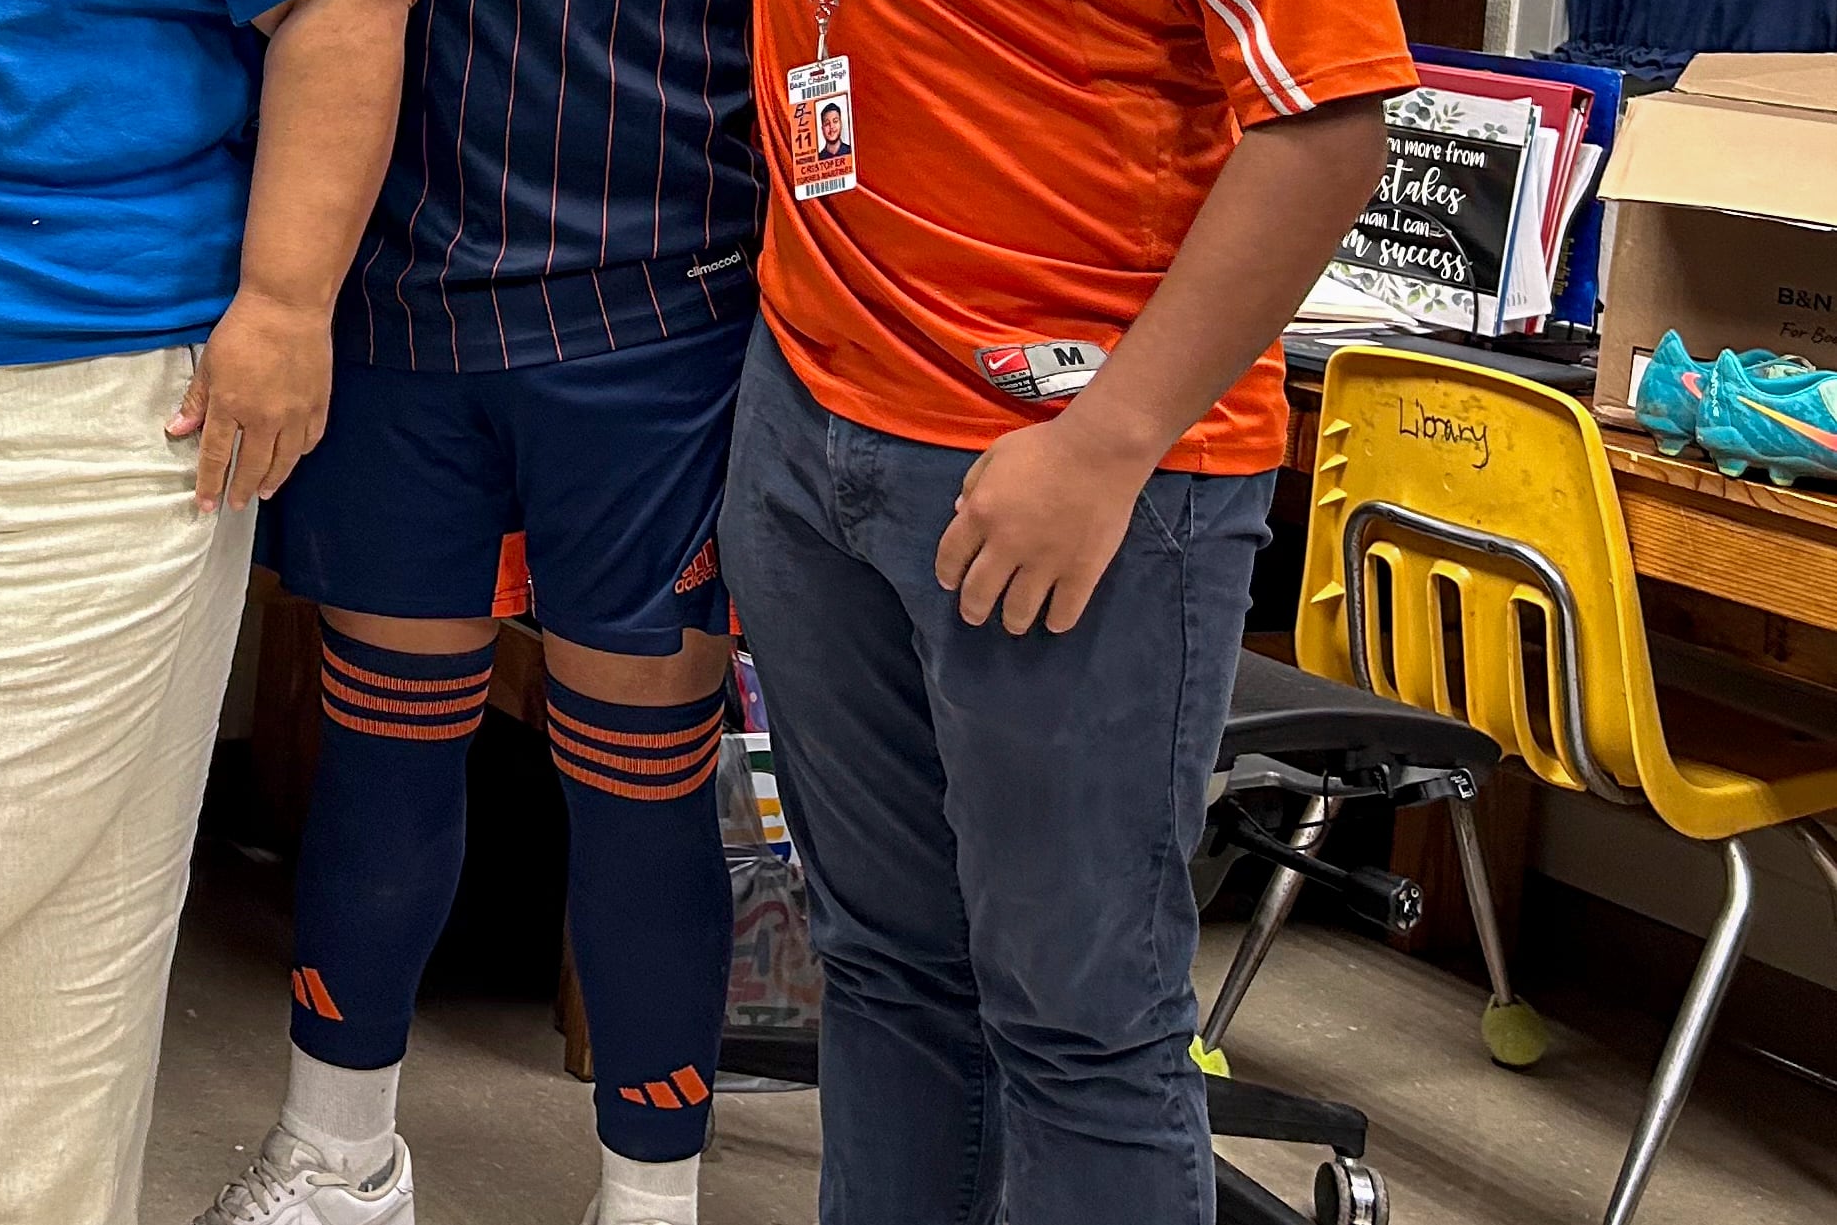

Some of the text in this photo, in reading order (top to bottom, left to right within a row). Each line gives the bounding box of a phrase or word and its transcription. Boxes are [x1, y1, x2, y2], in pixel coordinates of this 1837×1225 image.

[794, 131, 812, 150] 11
[1404, 138, 1442, 160] more
[1444, 140, 1486, 169] from
[1374, 158, 1467, 215] stakes
[1390, 209, 1402, 231] I
[1402, 218, 1430, 238] can
[686, 250, 742, 278] climacool
[1378, 237, 1467, 282] success
[1778, 286, 1833, 313] B&N
[1779, 321, 1837, 345] For Boo
[1052, 346, 1086, 367] M
[1399, 396, 1489, 469] Library
